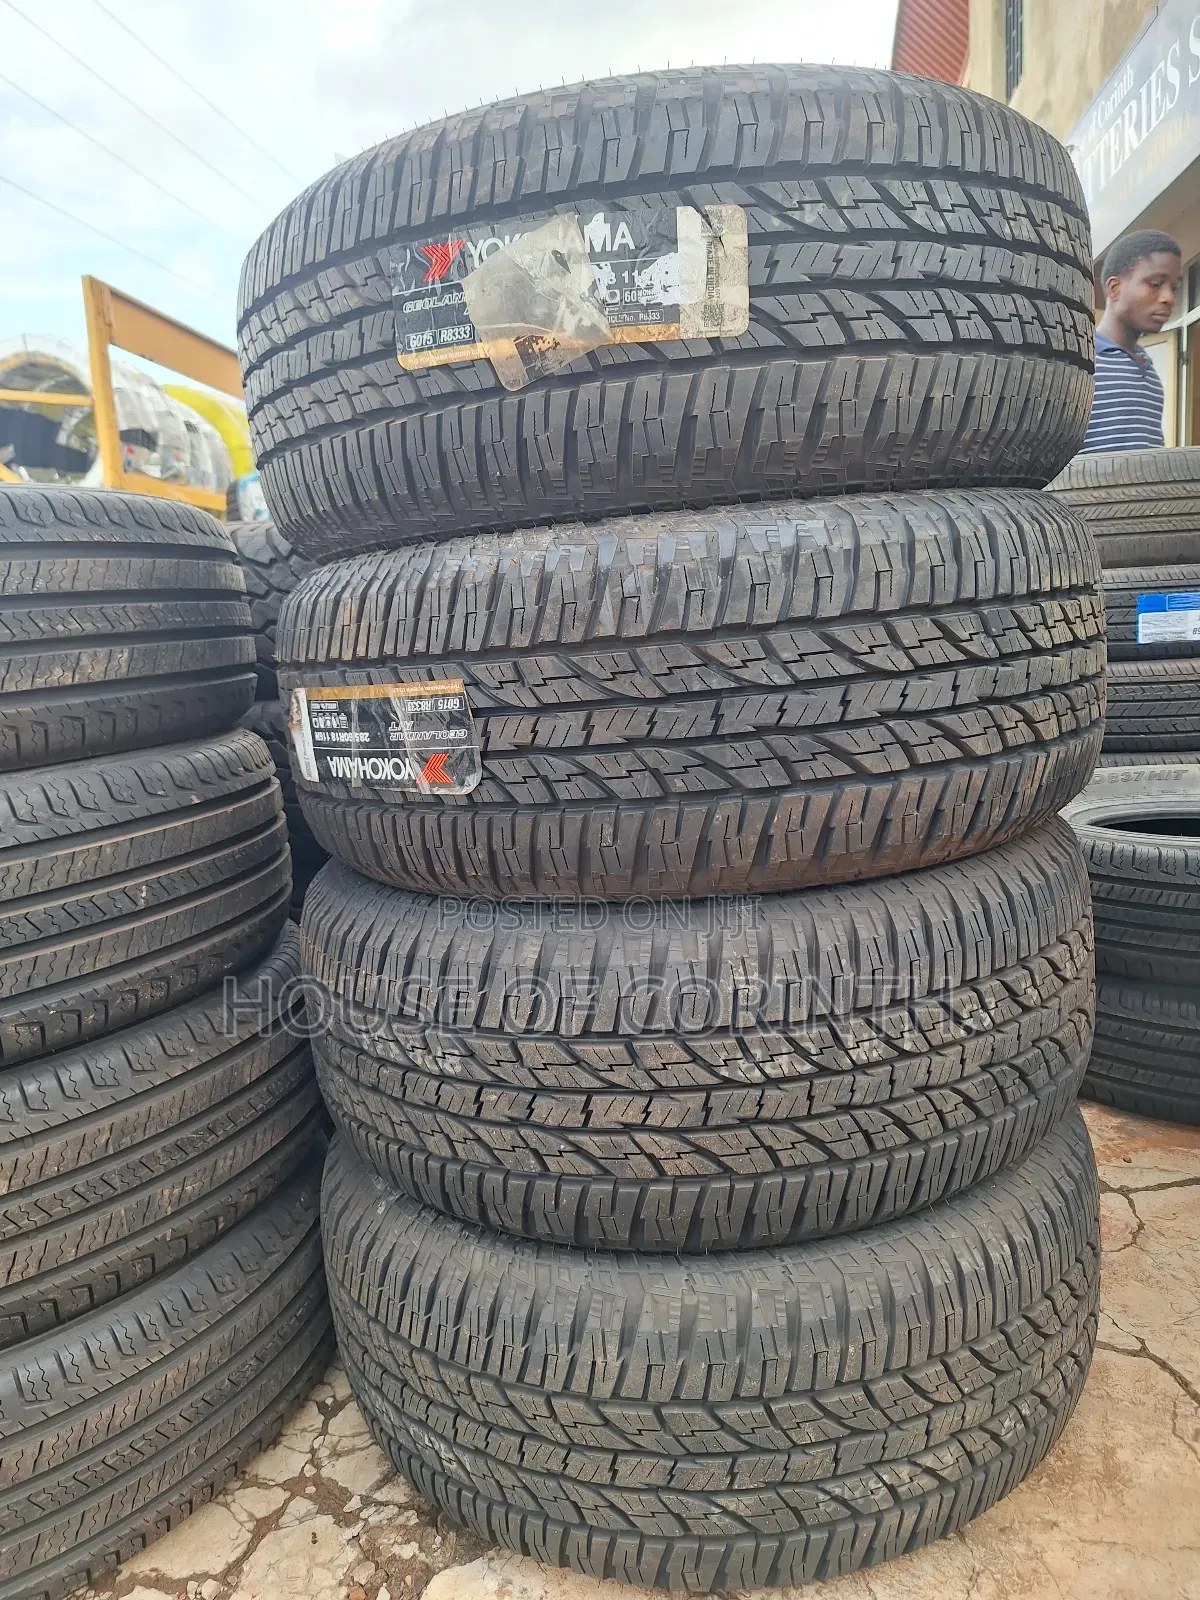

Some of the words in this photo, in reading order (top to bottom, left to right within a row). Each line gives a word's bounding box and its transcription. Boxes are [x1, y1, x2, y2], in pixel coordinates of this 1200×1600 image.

[1097, 63, 1134, 128] Corinth
[1083, 37, 1180, 204] TTERIES
[1188, 13, 1200, 88] S
[624, 291, 637, 303] 60
[409, 331, 434, 348] G015
[440, 325, 471, 343] R8333
[407, 700, 432, 712] R8333
[437, 698, 460, 710] G015
[326, 755, 416, 780] YOKOHAMA
